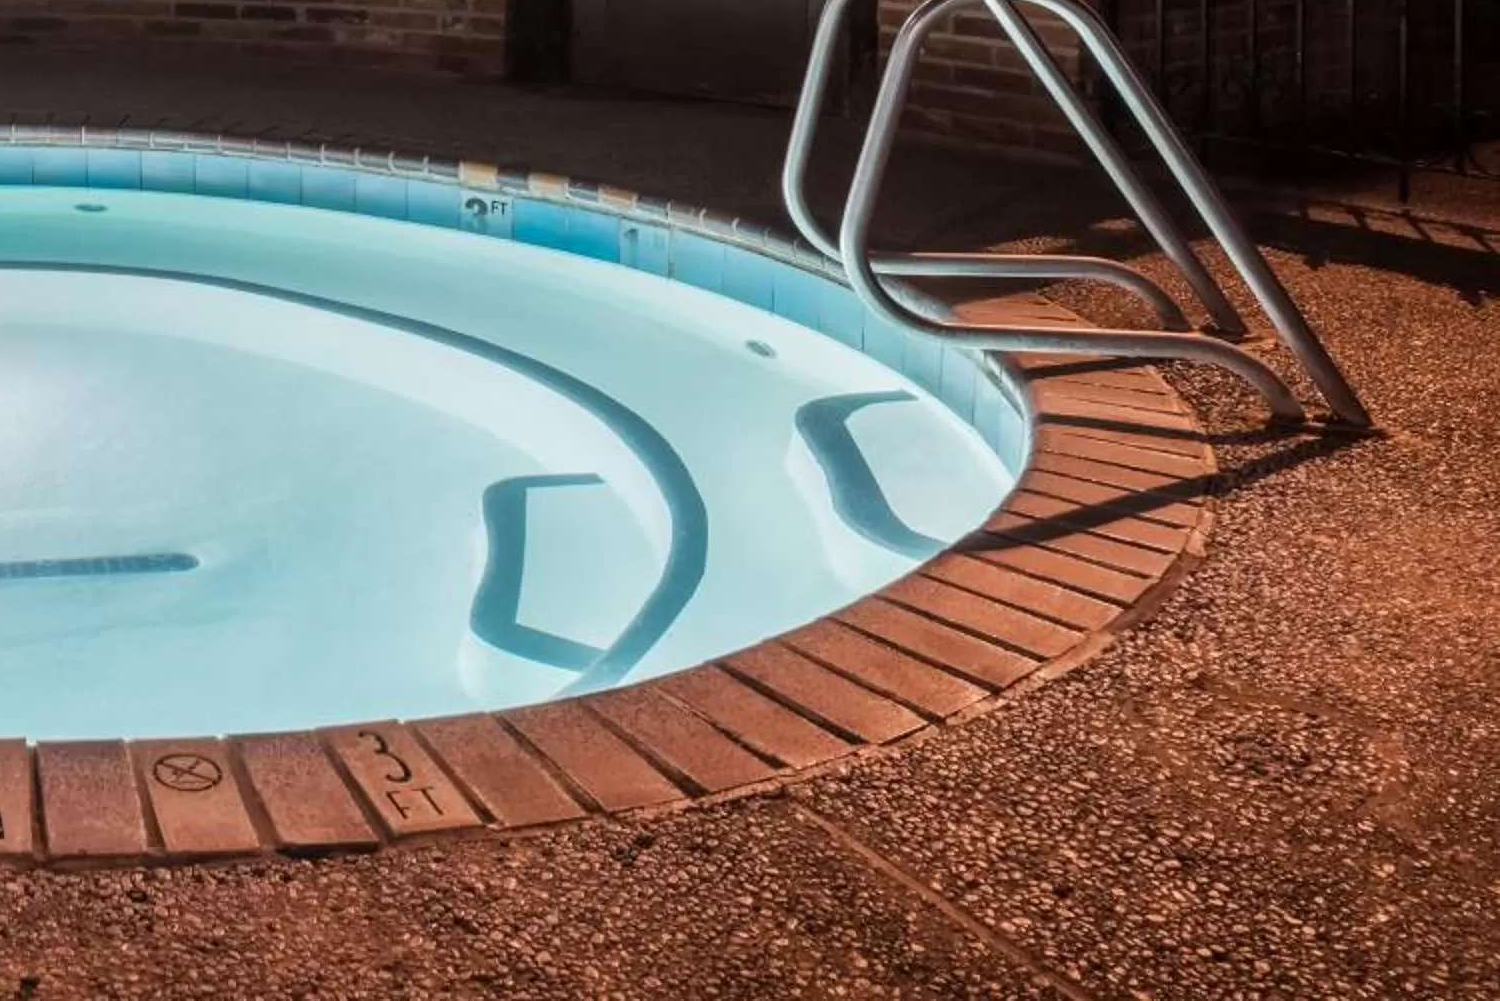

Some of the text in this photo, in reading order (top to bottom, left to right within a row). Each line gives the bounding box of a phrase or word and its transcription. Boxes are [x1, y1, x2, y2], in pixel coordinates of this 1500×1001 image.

[491, 200, 509, 216] FT
[357, 729, 412, 784] 3
[385, 785, 445, 820] FT
